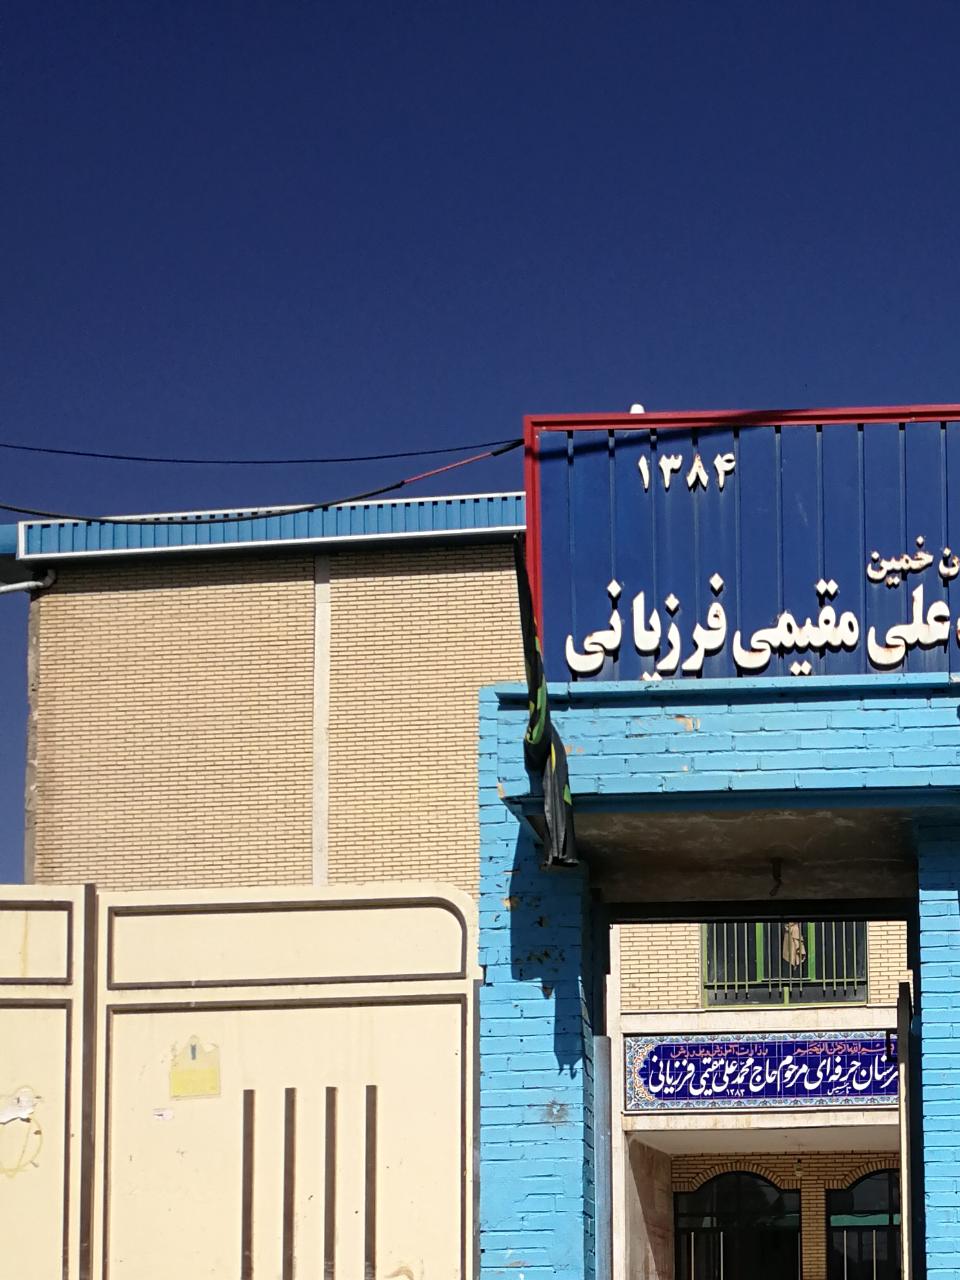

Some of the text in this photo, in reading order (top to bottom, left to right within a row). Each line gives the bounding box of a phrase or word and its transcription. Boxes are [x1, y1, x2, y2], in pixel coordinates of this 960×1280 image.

[637, 452, 737, 491] ۱۳۸۴
[866, 535, 934, 586] خمین
[732, 578, 860, 676] مقیمی
[689, 1057, 726, 1096] مقیمی
[748, 1058, 778, 1093] حاج
[776, 1055, 809, 1093] مرحوم
